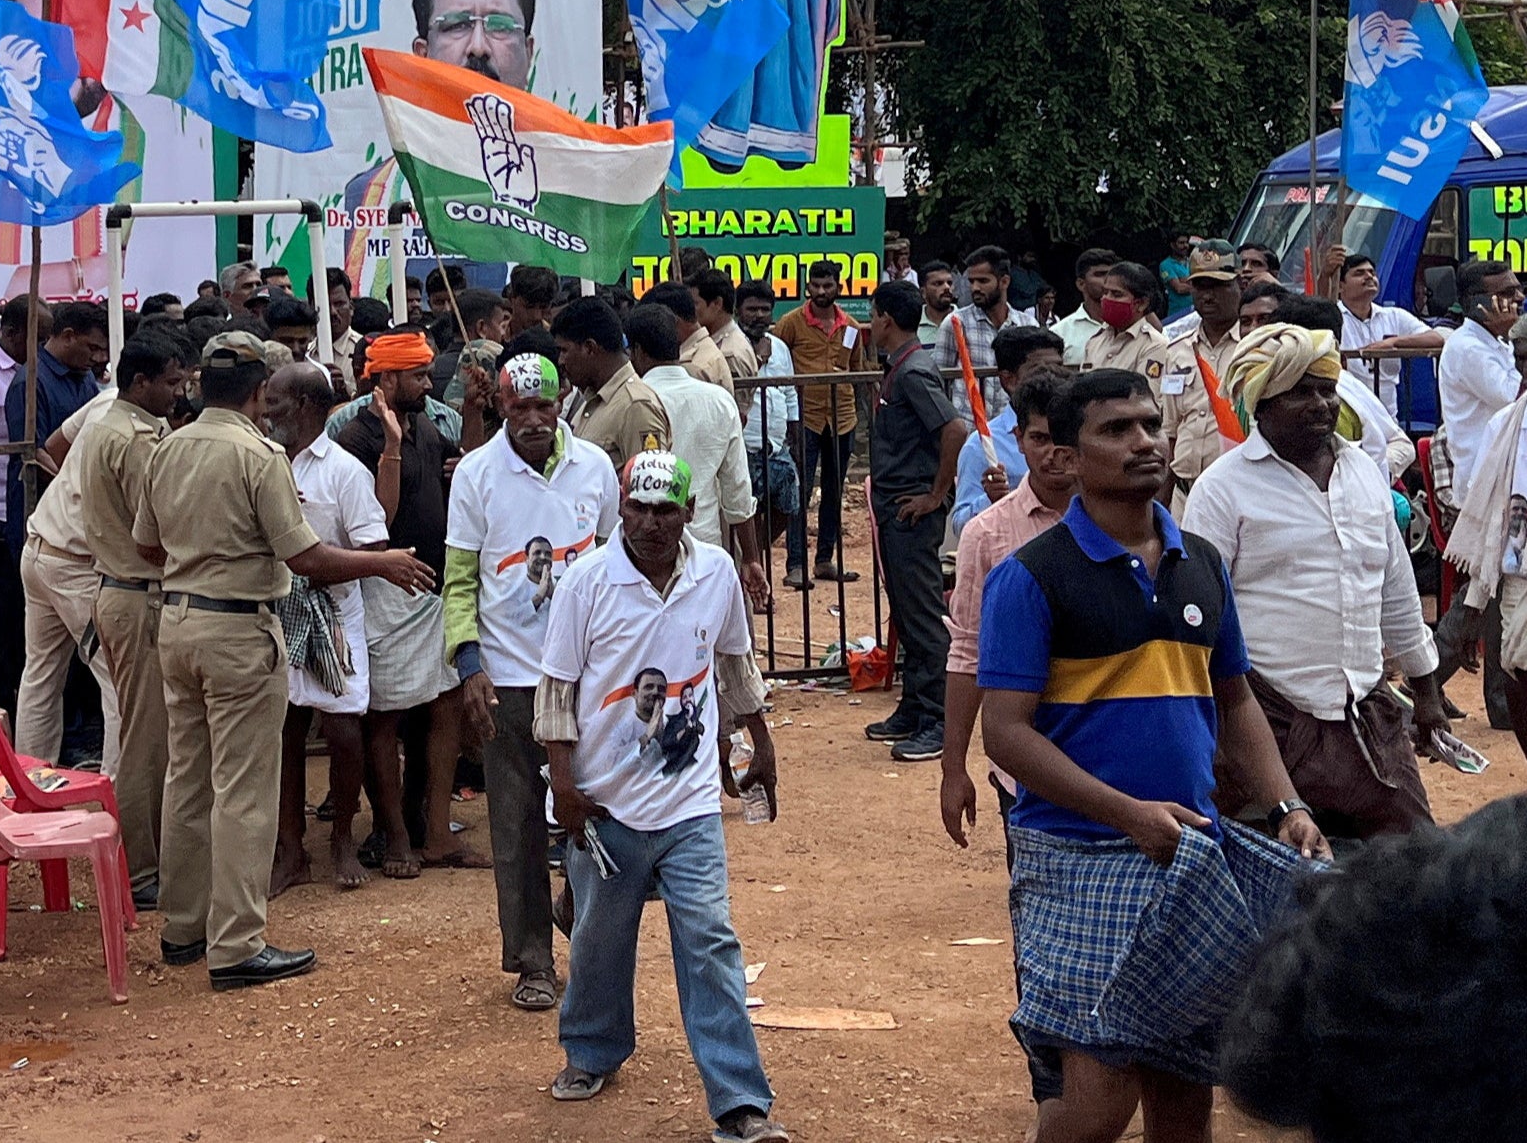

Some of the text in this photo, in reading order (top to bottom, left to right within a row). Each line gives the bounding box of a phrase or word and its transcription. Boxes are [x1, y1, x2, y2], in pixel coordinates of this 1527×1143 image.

[327, 209, 351, 227] Dr.
[355, 209, 387, 227] SYE
[445, 201, 589, 254] CONGRESS
[662, 208, 854, 236] BHARATH
